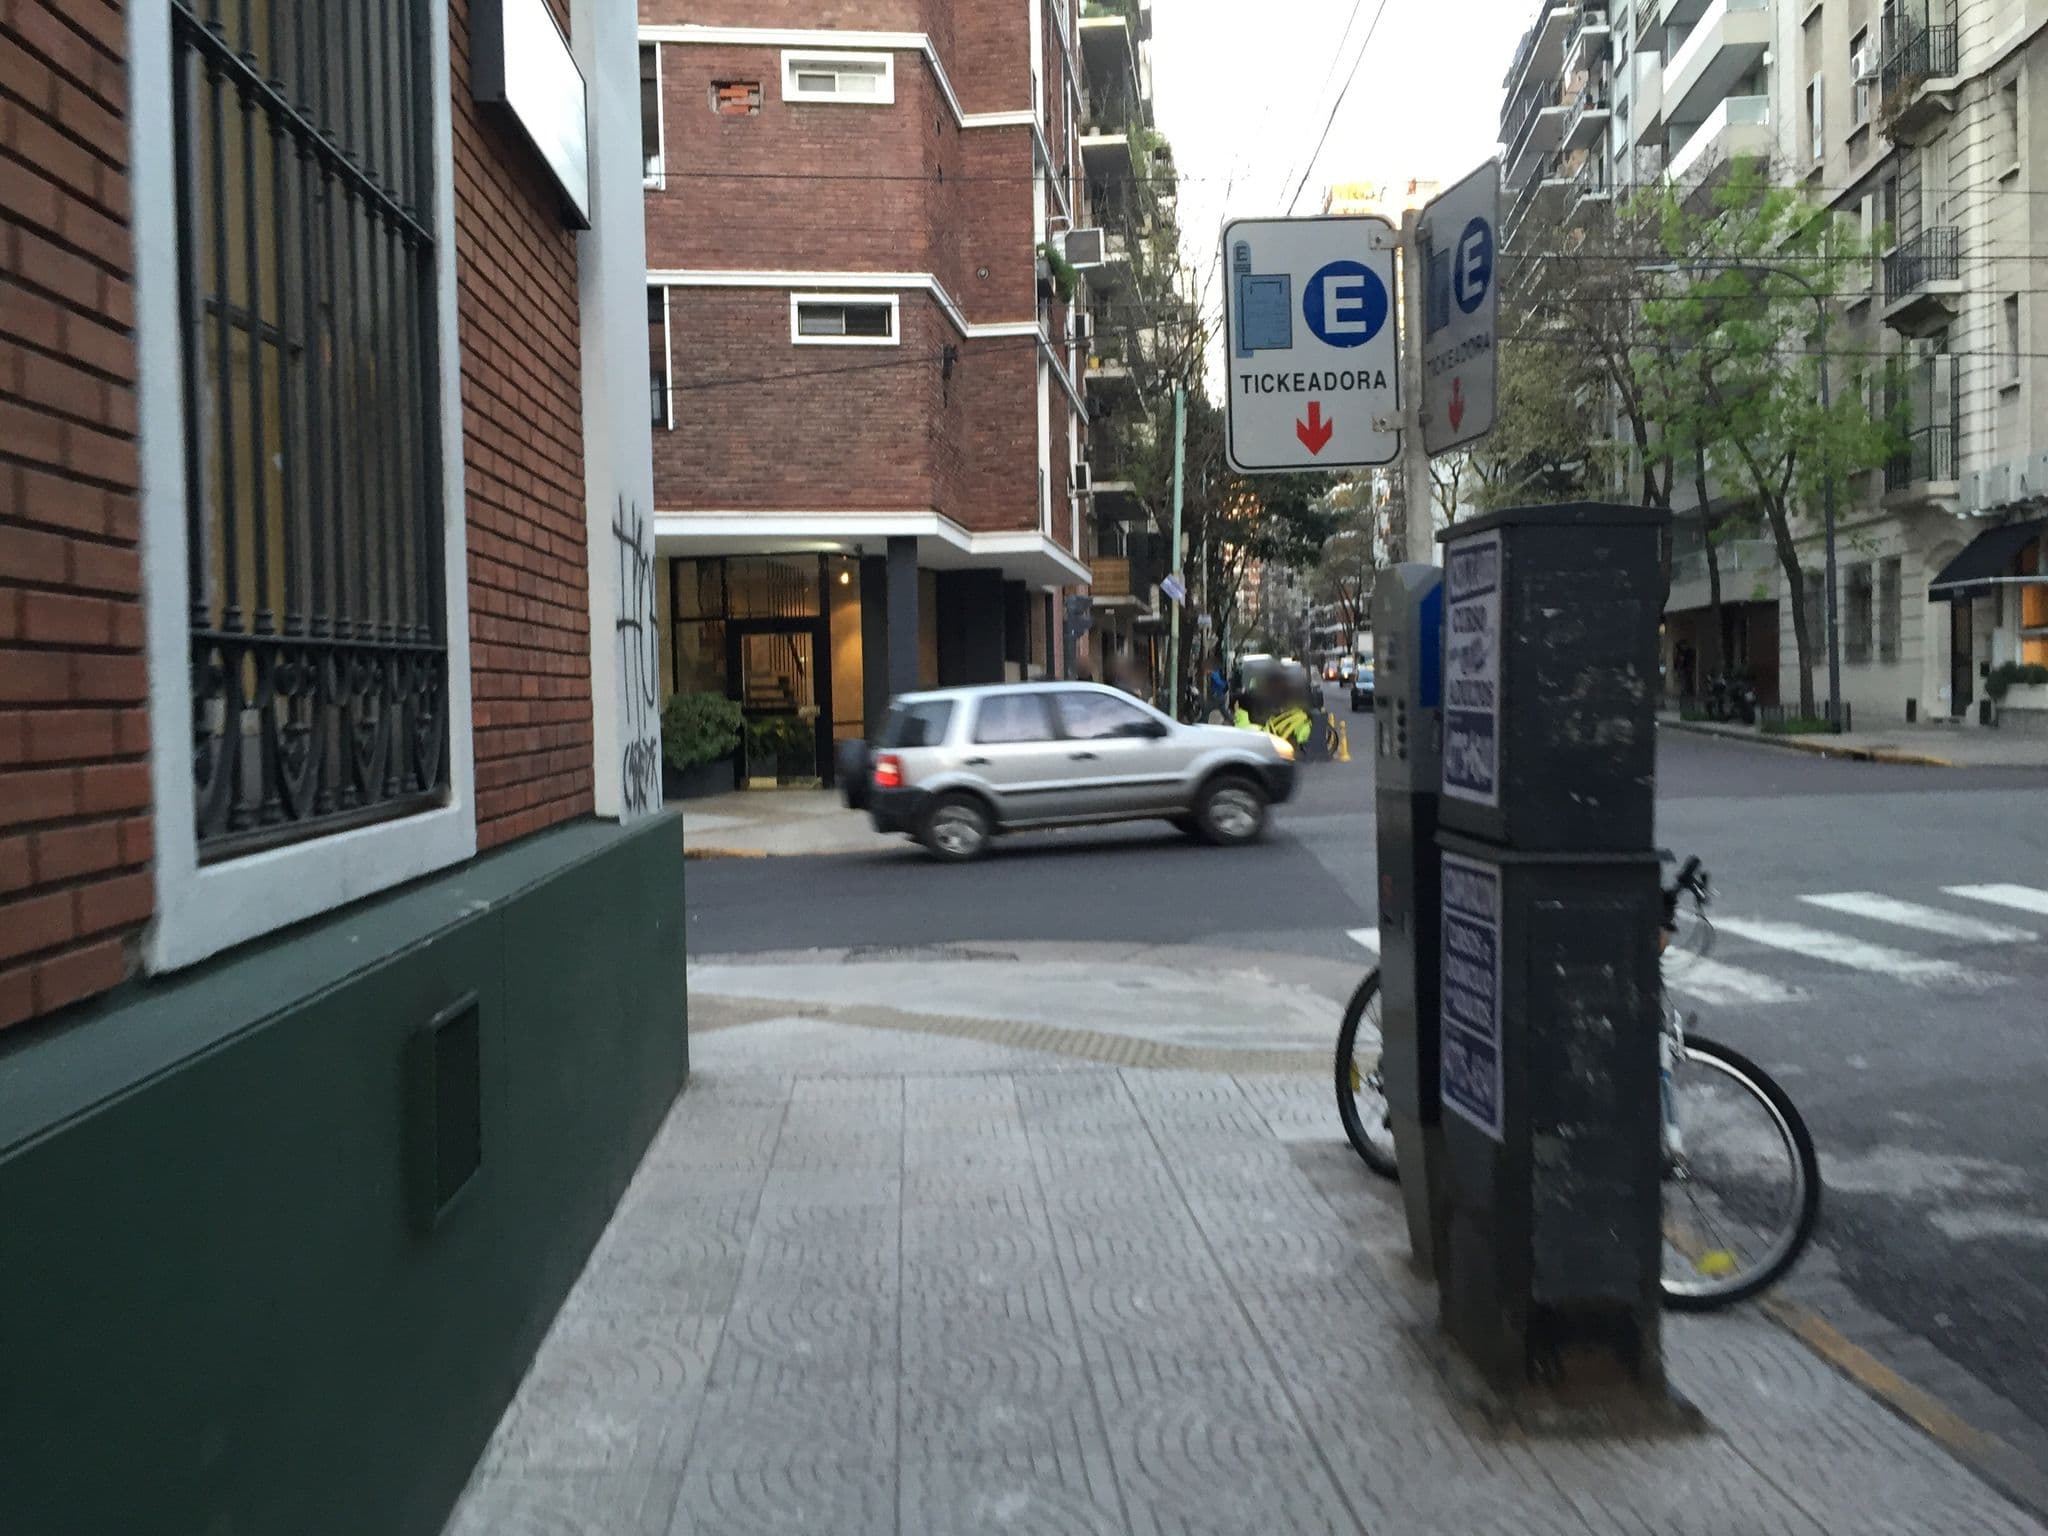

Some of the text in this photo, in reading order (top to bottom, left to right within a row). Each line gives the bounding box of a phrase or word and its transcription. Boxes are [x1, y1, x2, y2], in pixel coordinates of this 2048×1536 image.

[1236, 245, 1248, 262] E
[1462, 231, 1484, 299] E
[1322, 275, 1367, 334] E
[1427, 333, 1490, 375] TICKEADORA
[1240, 370, 1387, 394] TICKEADORA
